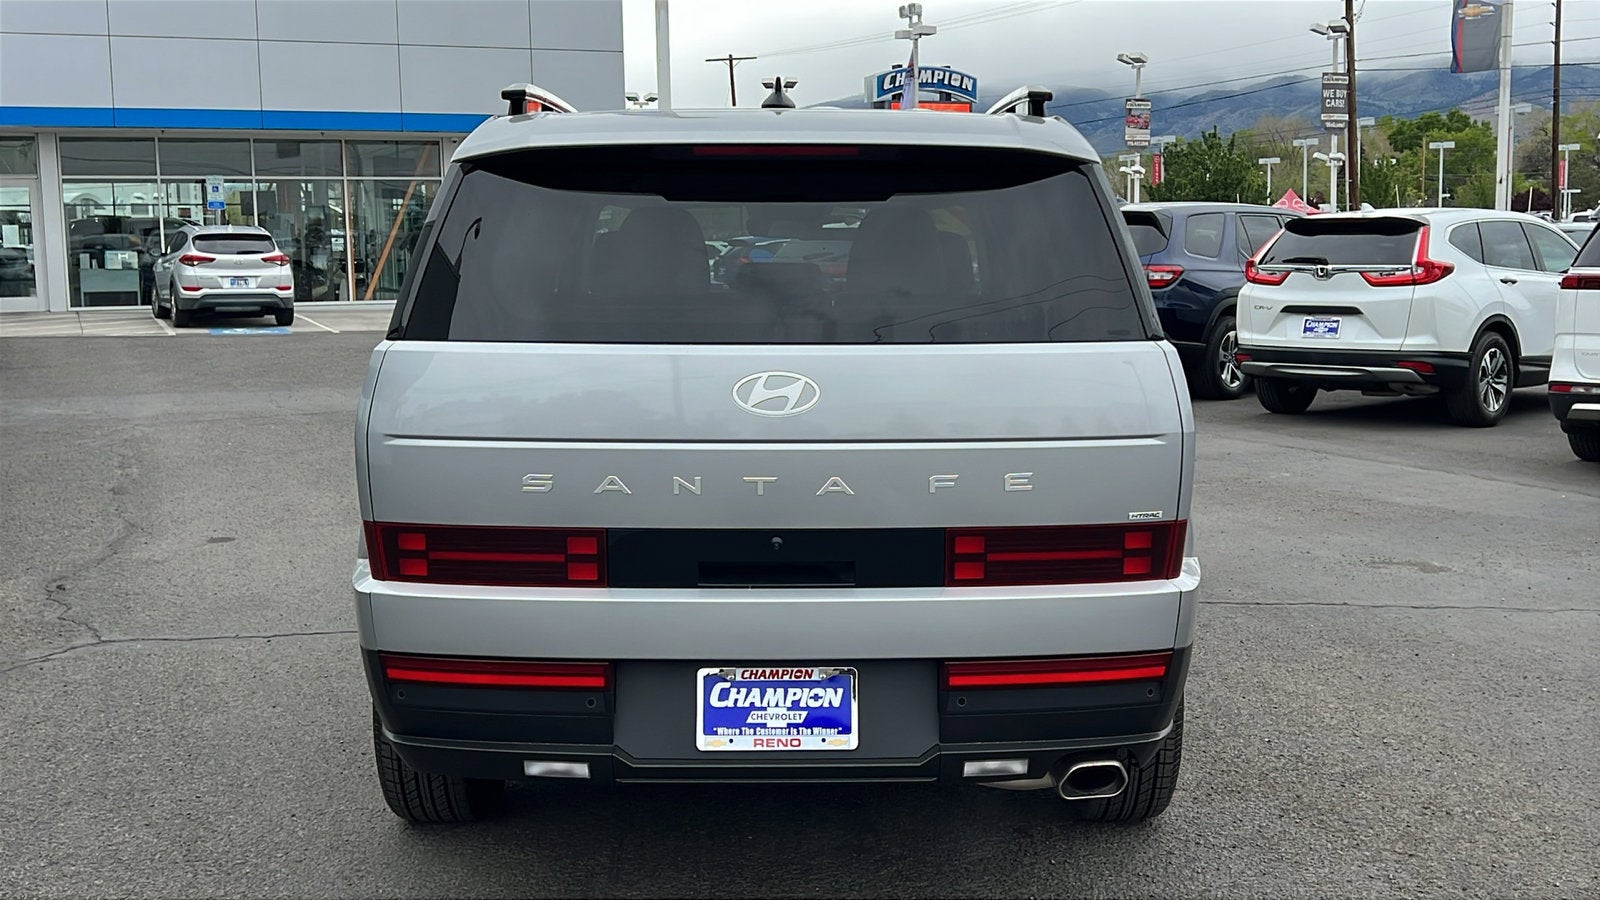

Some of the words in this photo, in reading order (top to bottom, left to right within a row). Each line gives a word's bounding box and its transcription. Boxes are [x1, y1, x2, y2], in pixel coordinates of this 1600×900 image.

[883, 69, 974, 91] CHMPION
[1323, 89, 1335, 98] WE
[1336, 89, 1347, 98] BUY
[1325, 99, 1345, 108] CARS!
[1306, 321, 1338, 329] CHAMPION
[521, 473, 854, 496] SANTA
[928, 472, 1034, 493] FE
[741, 669, 814, 679] CHAMPION
[709, 682, 843, 707] CHAMPION
[750, 713, 803, 721] CHEVROLET
[741, 727, 754, 736] The
[755, 727, 789, 736] Customer
[799, 727, 812, 736] The
[753, 738, 801, 748] RENO
